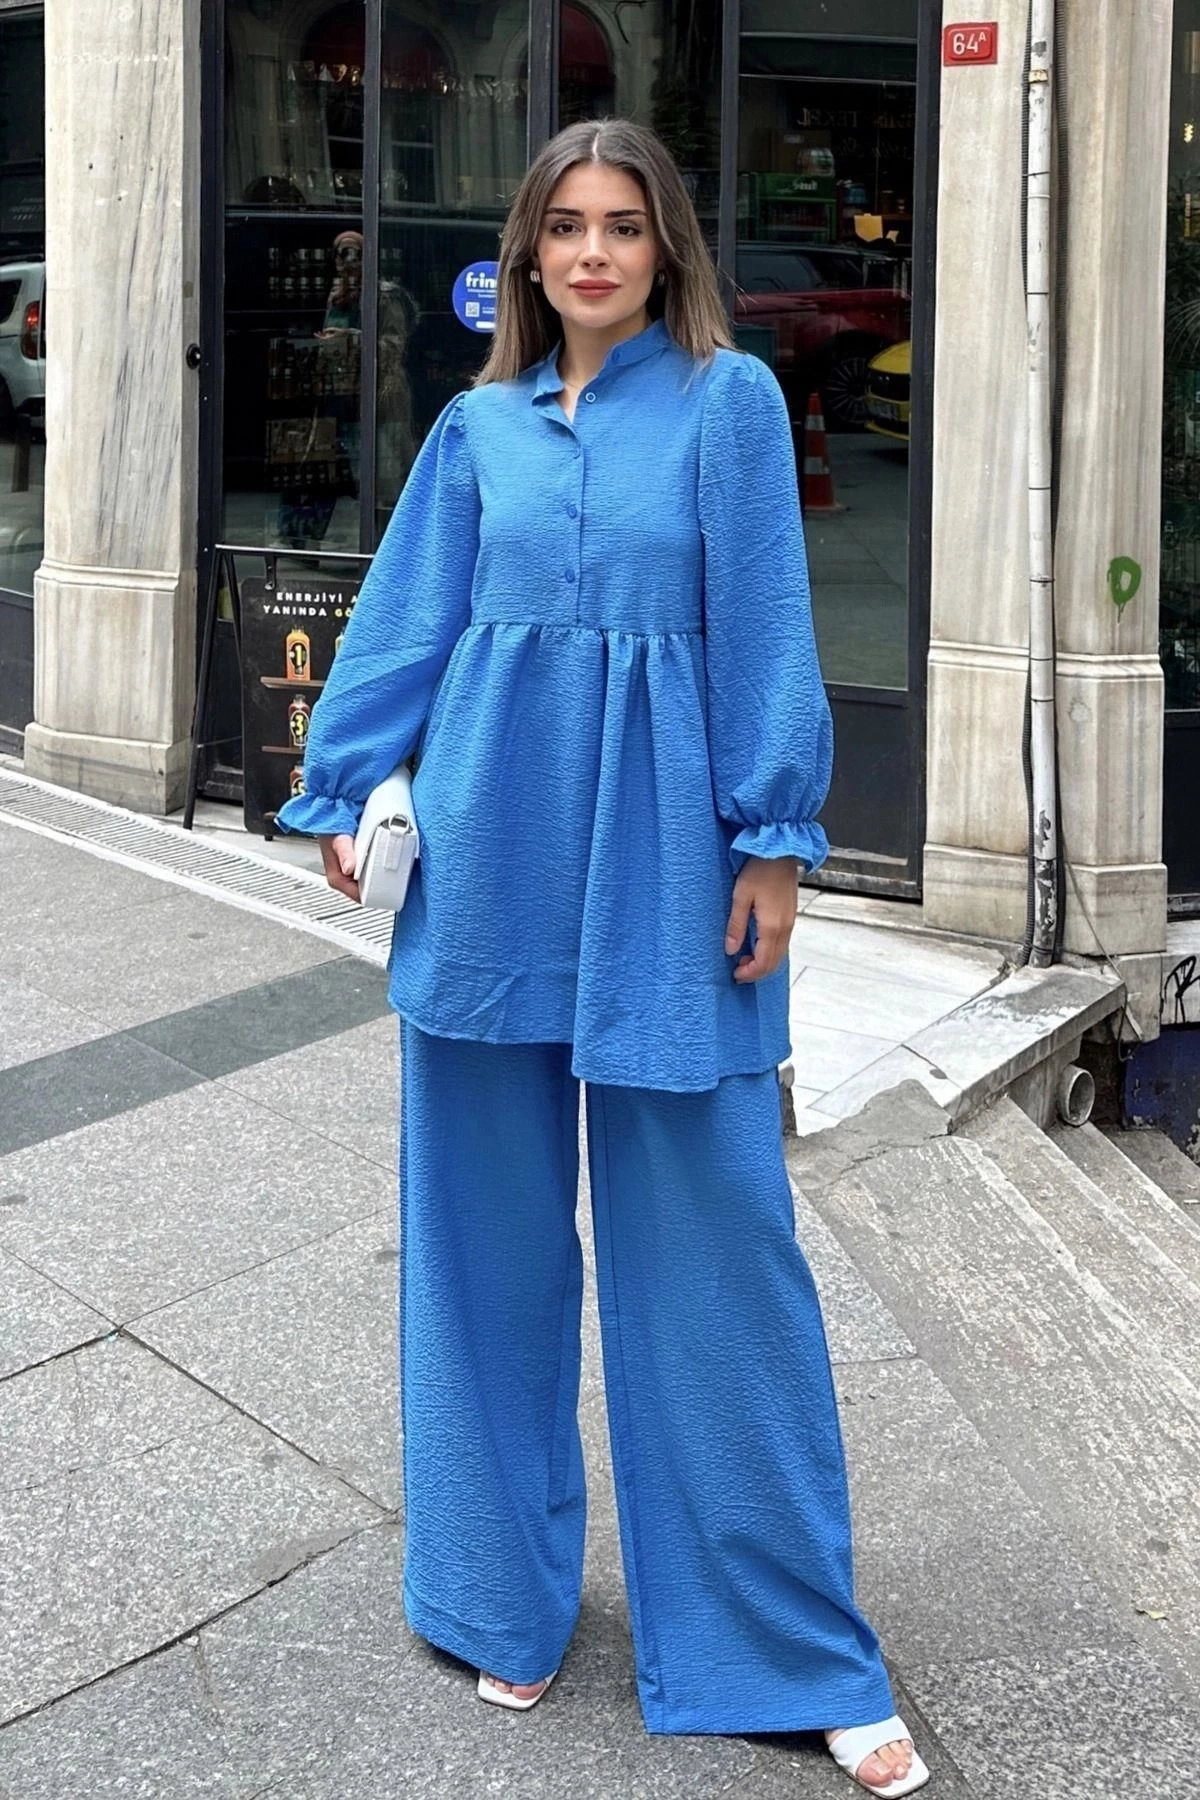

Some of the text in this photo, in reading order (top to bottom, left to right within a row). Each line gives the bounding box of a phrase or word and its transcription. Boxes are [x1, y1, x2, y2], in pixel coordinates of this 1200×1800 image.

[466, 271, 498, 288] frin
[263, 605, 328, 617] YANINDA
[295, 714, 304, 735] 3
